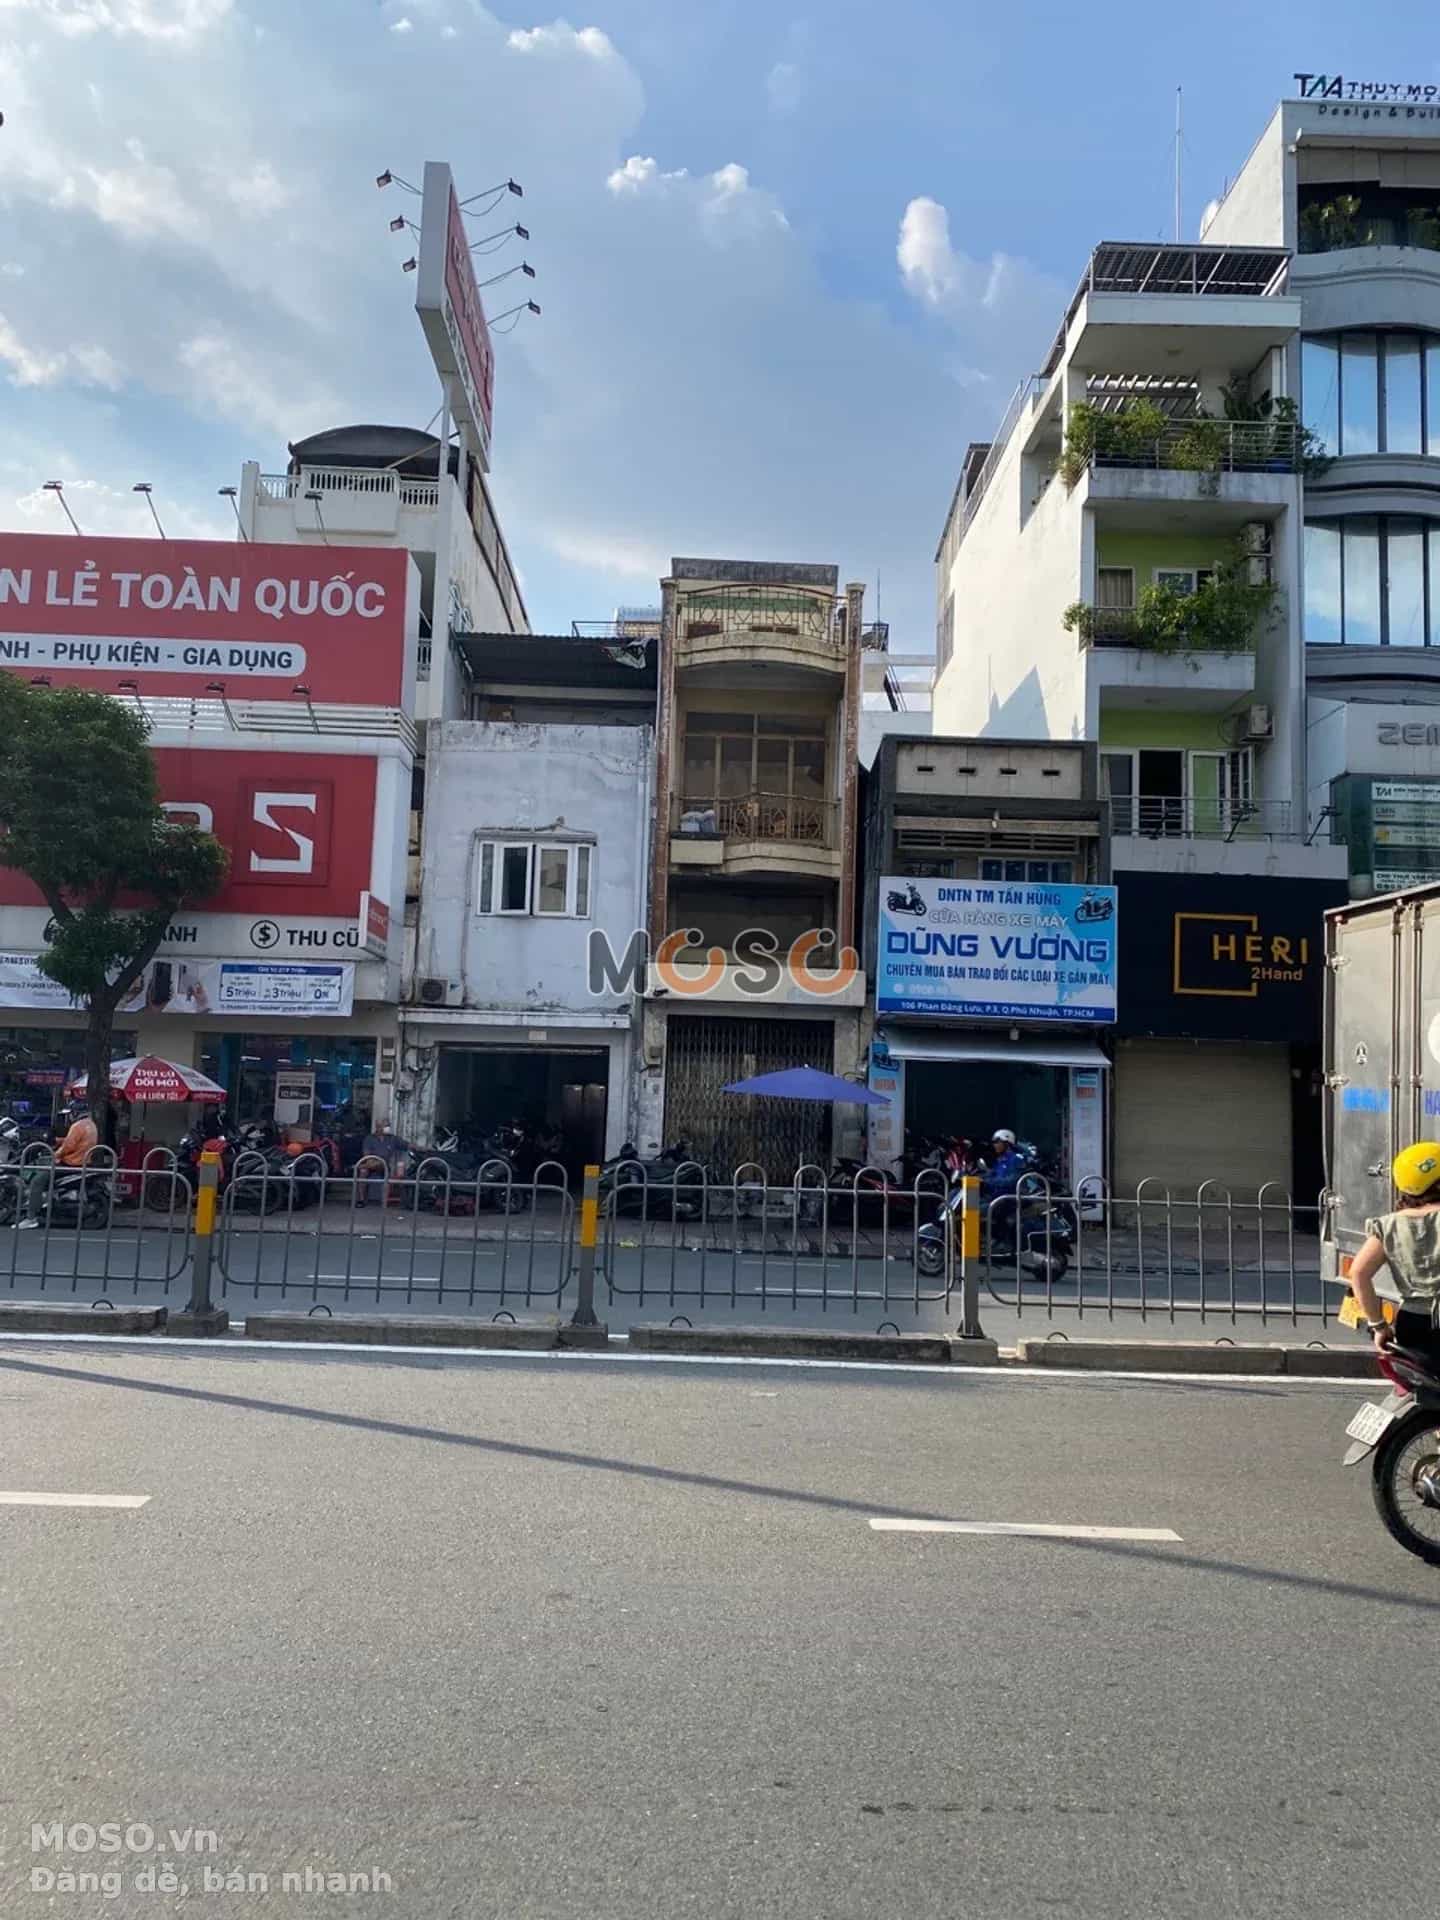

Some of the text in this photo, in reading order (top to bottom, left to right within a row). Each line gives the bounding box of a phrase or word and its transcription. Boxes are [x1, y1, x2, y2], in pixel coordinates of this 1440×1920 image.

[1348, 82, 1400, 95] THUY
[1319, 104, 1380, 120] Design
[1388, 106, 1397, 117] &
[46, 560, 100, 607] LẺ
[111, 566, 240, 613] TOÀN
[255, 571, 385, 619] QUỐC
[53, 643, 100, 665] PHỤ
[108, 642, 160, 667] KIỆN
[183, 647, 222, 666] GIA
[229, 650, 293, 671] DỤNG
[938, 887, 971, 902] DNTN
[976, 889, 994, 904] TM
[964, 908, 1007, 926] HÀNG
[1009, 913, 1033, 926] XE
[286, 929, 327, 946] THU
[332, 928, 359, 948] CŨ
[887, 926, 1107, 962] DŨNG VƯƠNG
[1212, 934, 1308, 964] HERI
[886, 962, 922, 977] CHUYÊN
[925, 964, 945, 978] MUA
[968, 967, 991, 980] TRAO
[1011, 967, 1029, 982] CÁC
[1031, 970, 1051, 986] LOẠI
[1053, 971, 1065, 984] XE
[1251, 967, 1303, 981] 2Hand
[918, 1002, 939, 1011] Phan
[941, 1003, 963, 1013] Đăng
